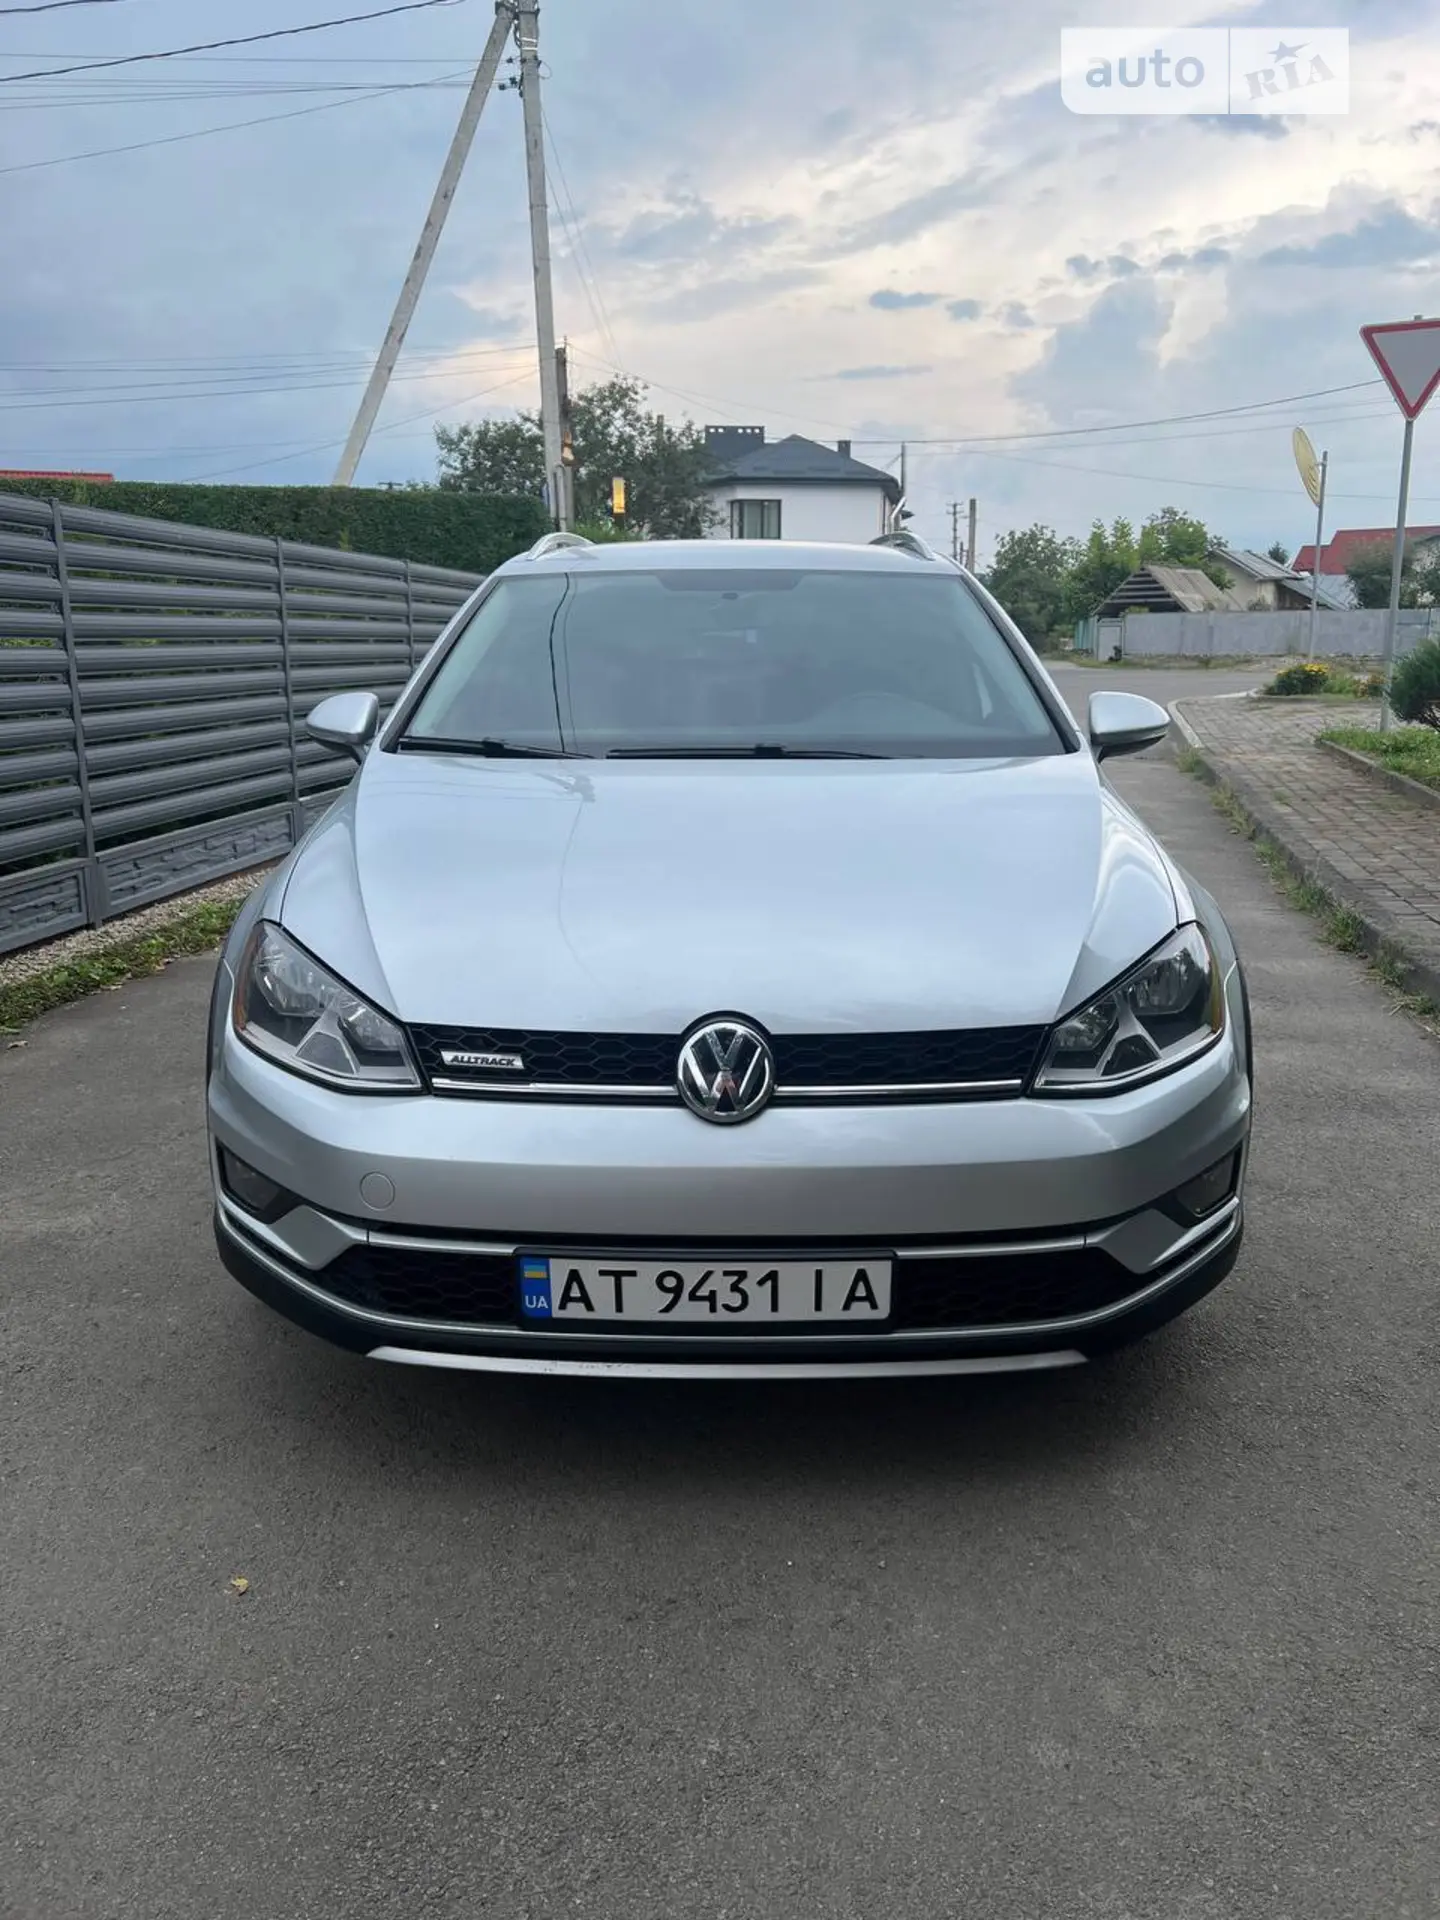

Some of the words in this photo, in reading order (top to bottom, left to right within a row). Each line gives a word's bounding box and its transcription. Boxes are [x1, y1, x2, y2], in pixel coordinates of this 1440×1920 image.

[449, 1053, 518, 1068] ALLTRACK
[557, 1268, 638, 1313] AT
[654, 1269, 780, 1313] 9431
[813, 1268, 880, 1312] IA
[524, 1295, 549, 1309] UA
